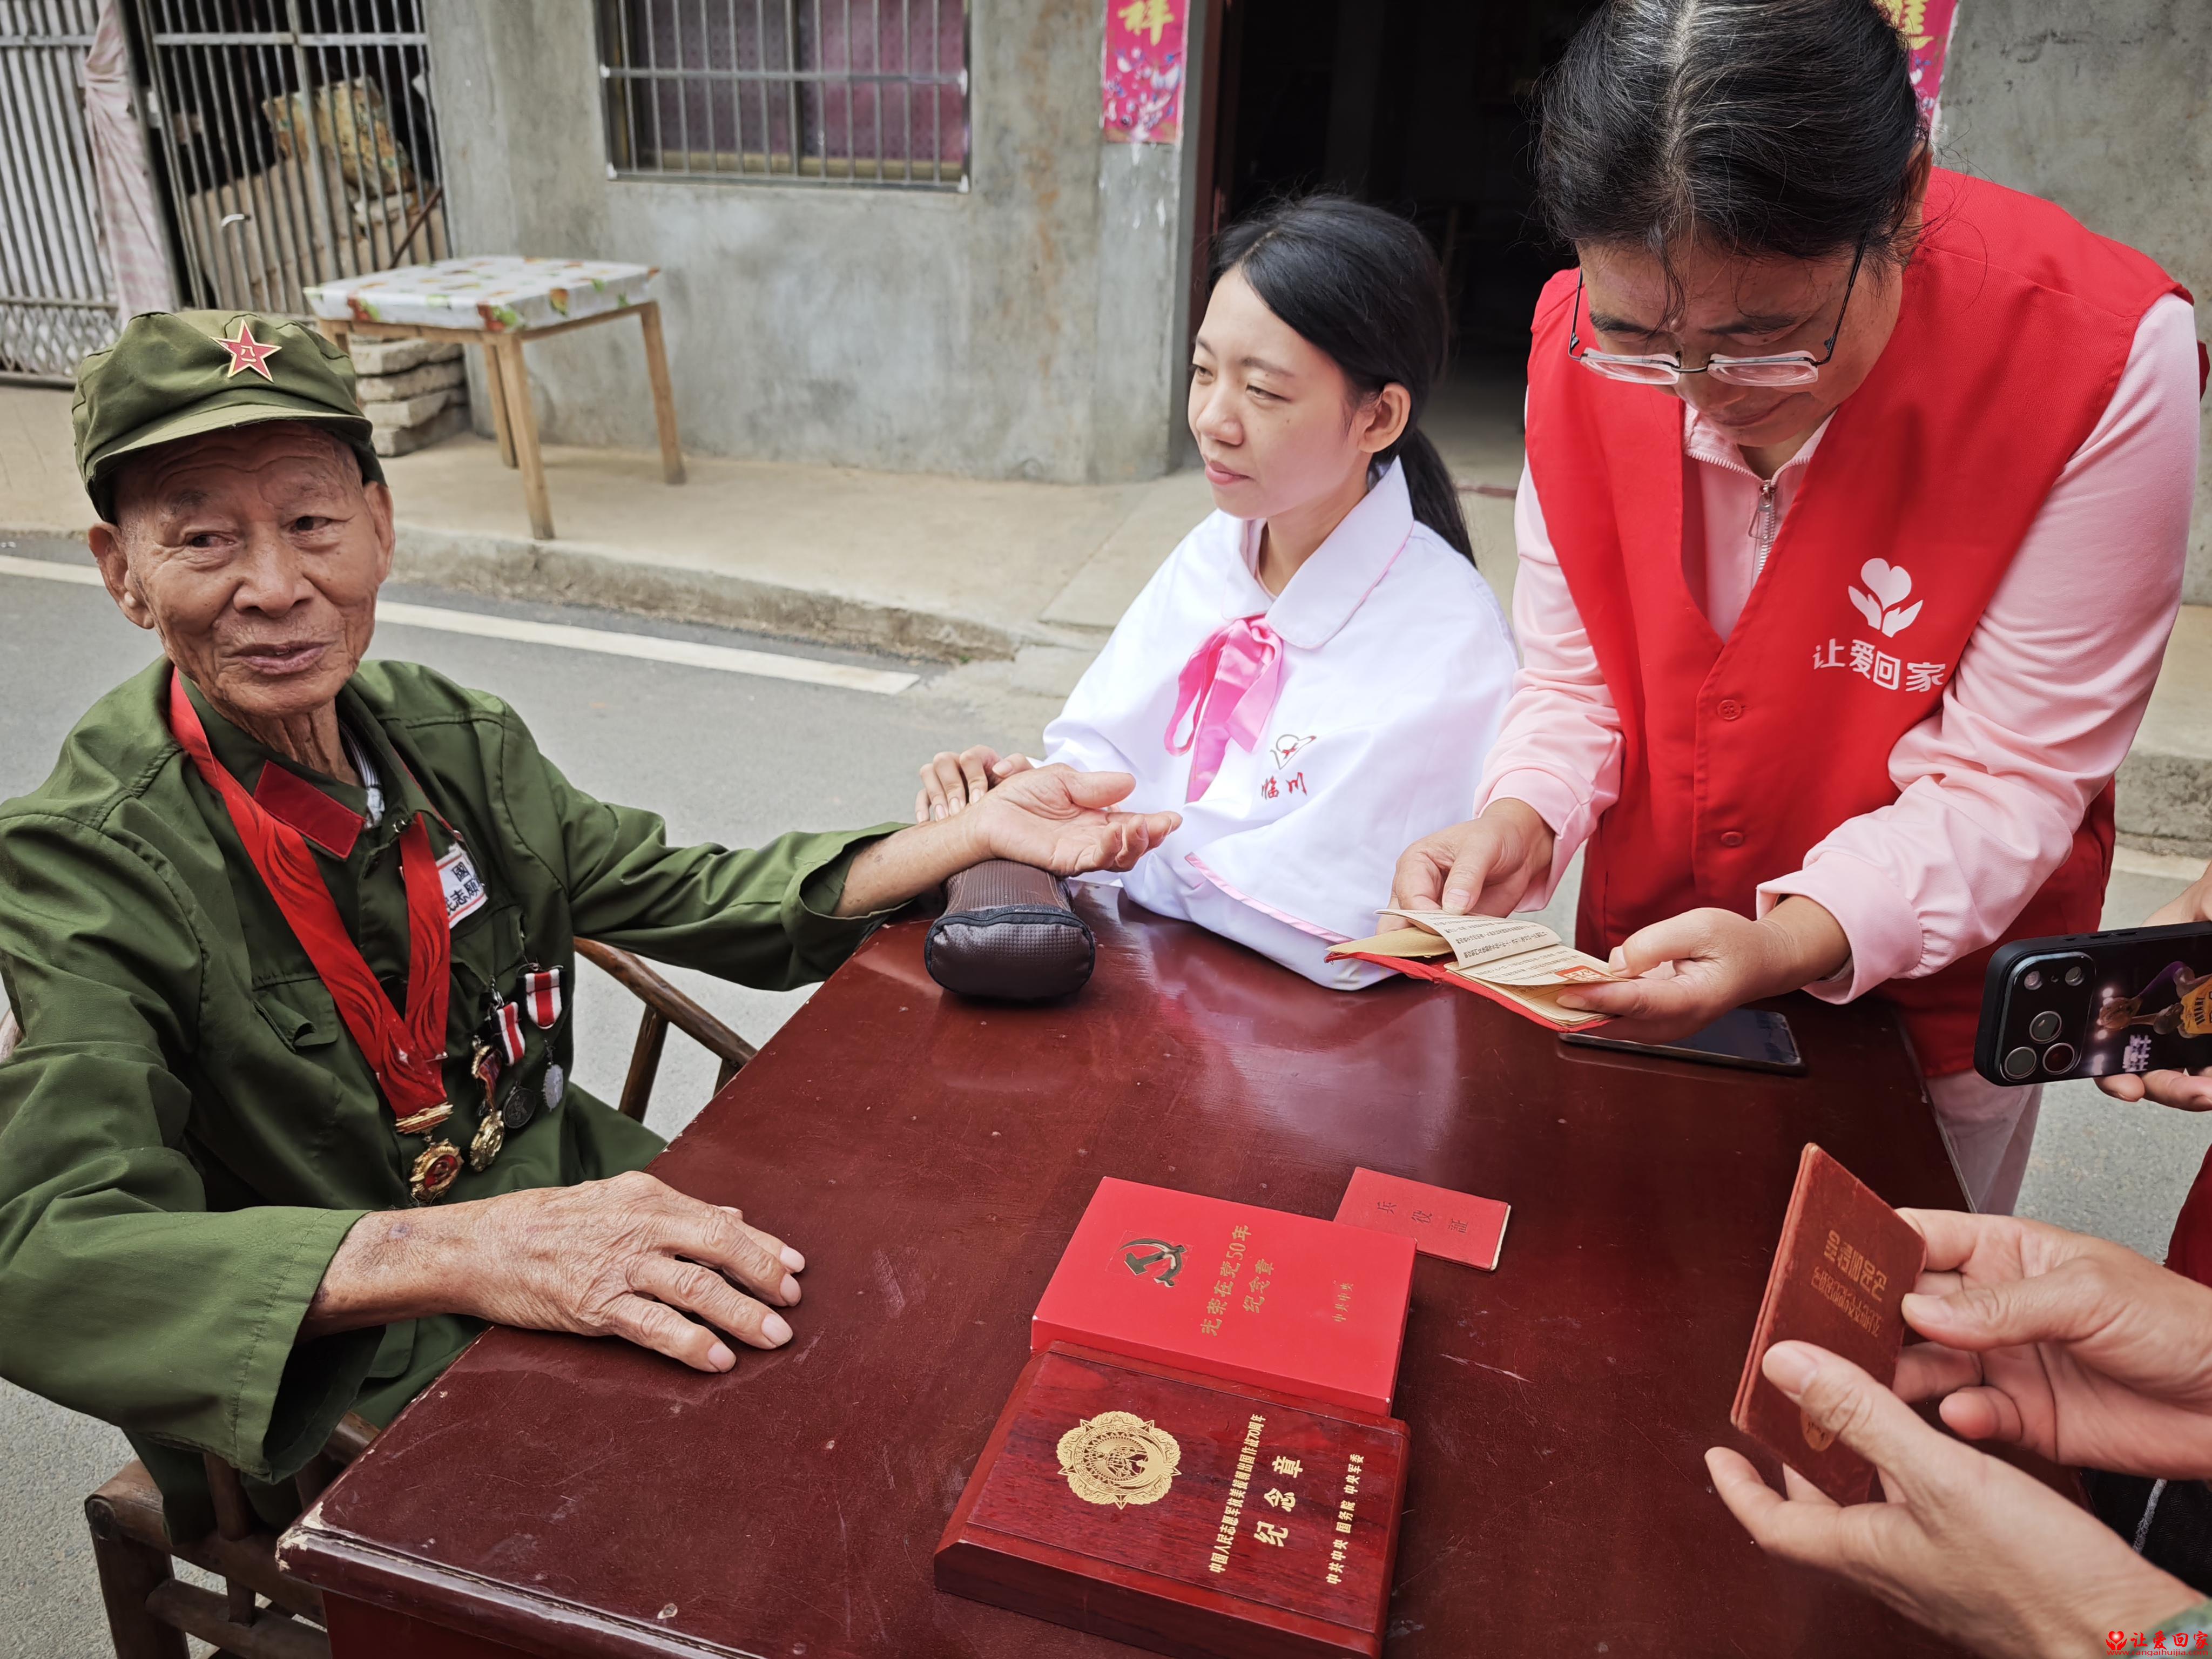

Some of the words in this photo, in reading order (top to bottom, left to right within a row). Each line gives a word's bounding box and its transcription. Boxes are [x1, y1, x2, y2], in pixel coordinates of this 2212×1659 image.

[1812, 638, 1946, 693] 让爱回家
[1261, 772, 1307, 800] 临川
[1200, 1225, 1252, 1337] 光荣在党50年
[1242, 1258, 1274, 1314] 纪念章
[1331, 1283, 1354, 1323] 中共中央
[1209, 1413, 1266, 1573] 中国人民志愿军抗美援朝出国作战70周年
[1343, 1453, 1365, 1495] 中央军委
[1253, 1455, 1304, 1547] 纪念章
[1335, 1500, 1356, 1534] 国务院
[1326, 1539, 1349, 1585] 中共中央
